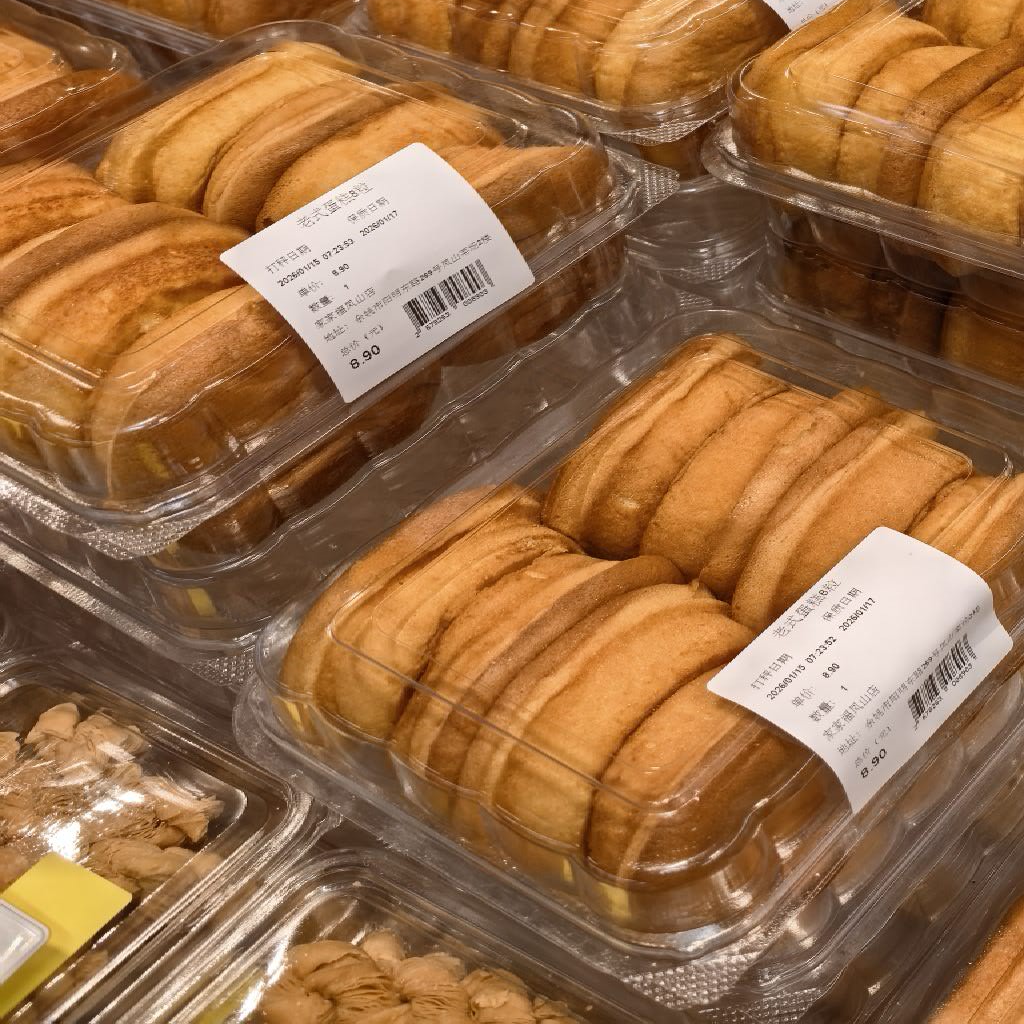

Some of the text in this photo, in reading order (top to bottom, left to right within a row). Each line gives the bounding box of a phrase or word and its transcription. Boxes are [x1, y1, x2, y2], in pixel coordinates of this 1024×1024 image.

[277, 259, 320, 286] 2026/01/15
[360, 210, 397, 236] 2026/01/17
[332, 264, 349, 276] 8.90
[349, 345, 380, 369] 8.90
[767, 664, 805, 700] 2026/01/15
[839, 598, 875, 631] 2026/01/17
[823, 663, 840, 678] 8.90
[861, 748, 887, 778] 8.90
